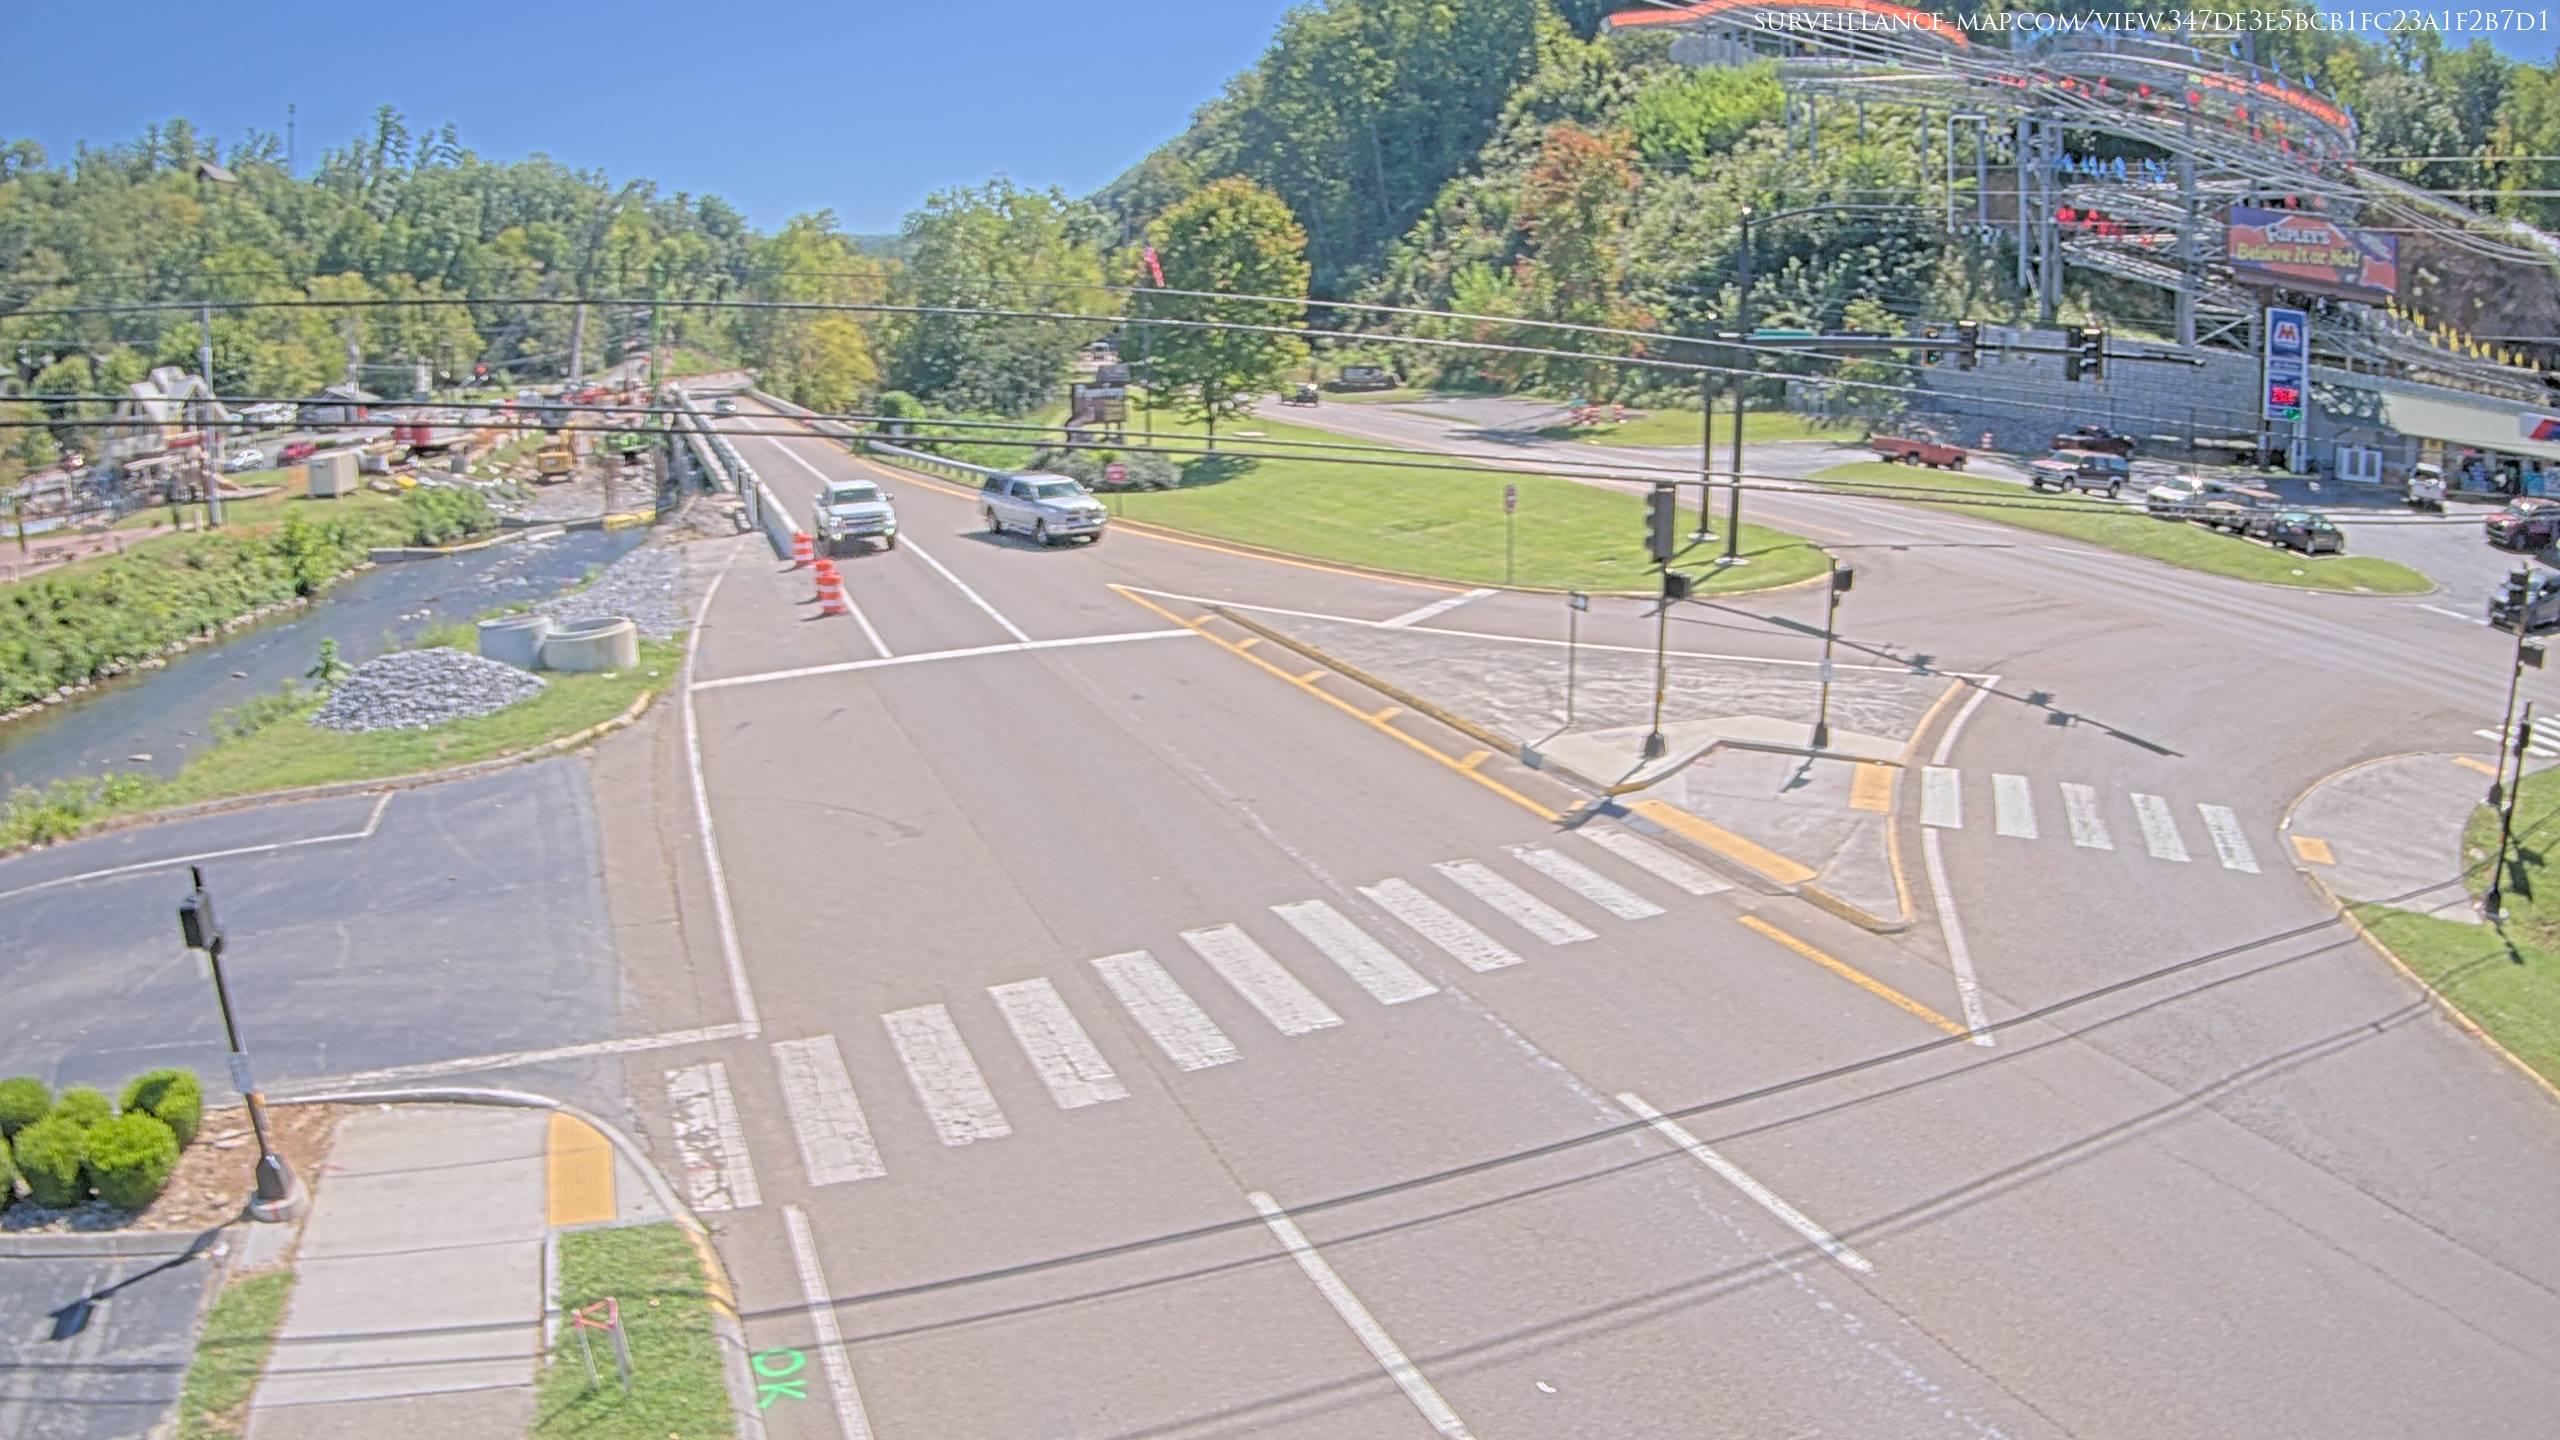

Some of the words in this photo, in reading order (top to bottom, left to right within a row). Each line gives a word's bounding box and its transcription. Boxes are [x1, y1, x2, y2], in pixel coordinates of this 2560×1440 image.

[2236, 242, 2291, 263] Believe
[2293, 246, 2308, 264] It
[2308, 251, 2327, 265] or
[2329, 248, 2361, 267] Not!
[752, 1346, 808, 1409] OK
